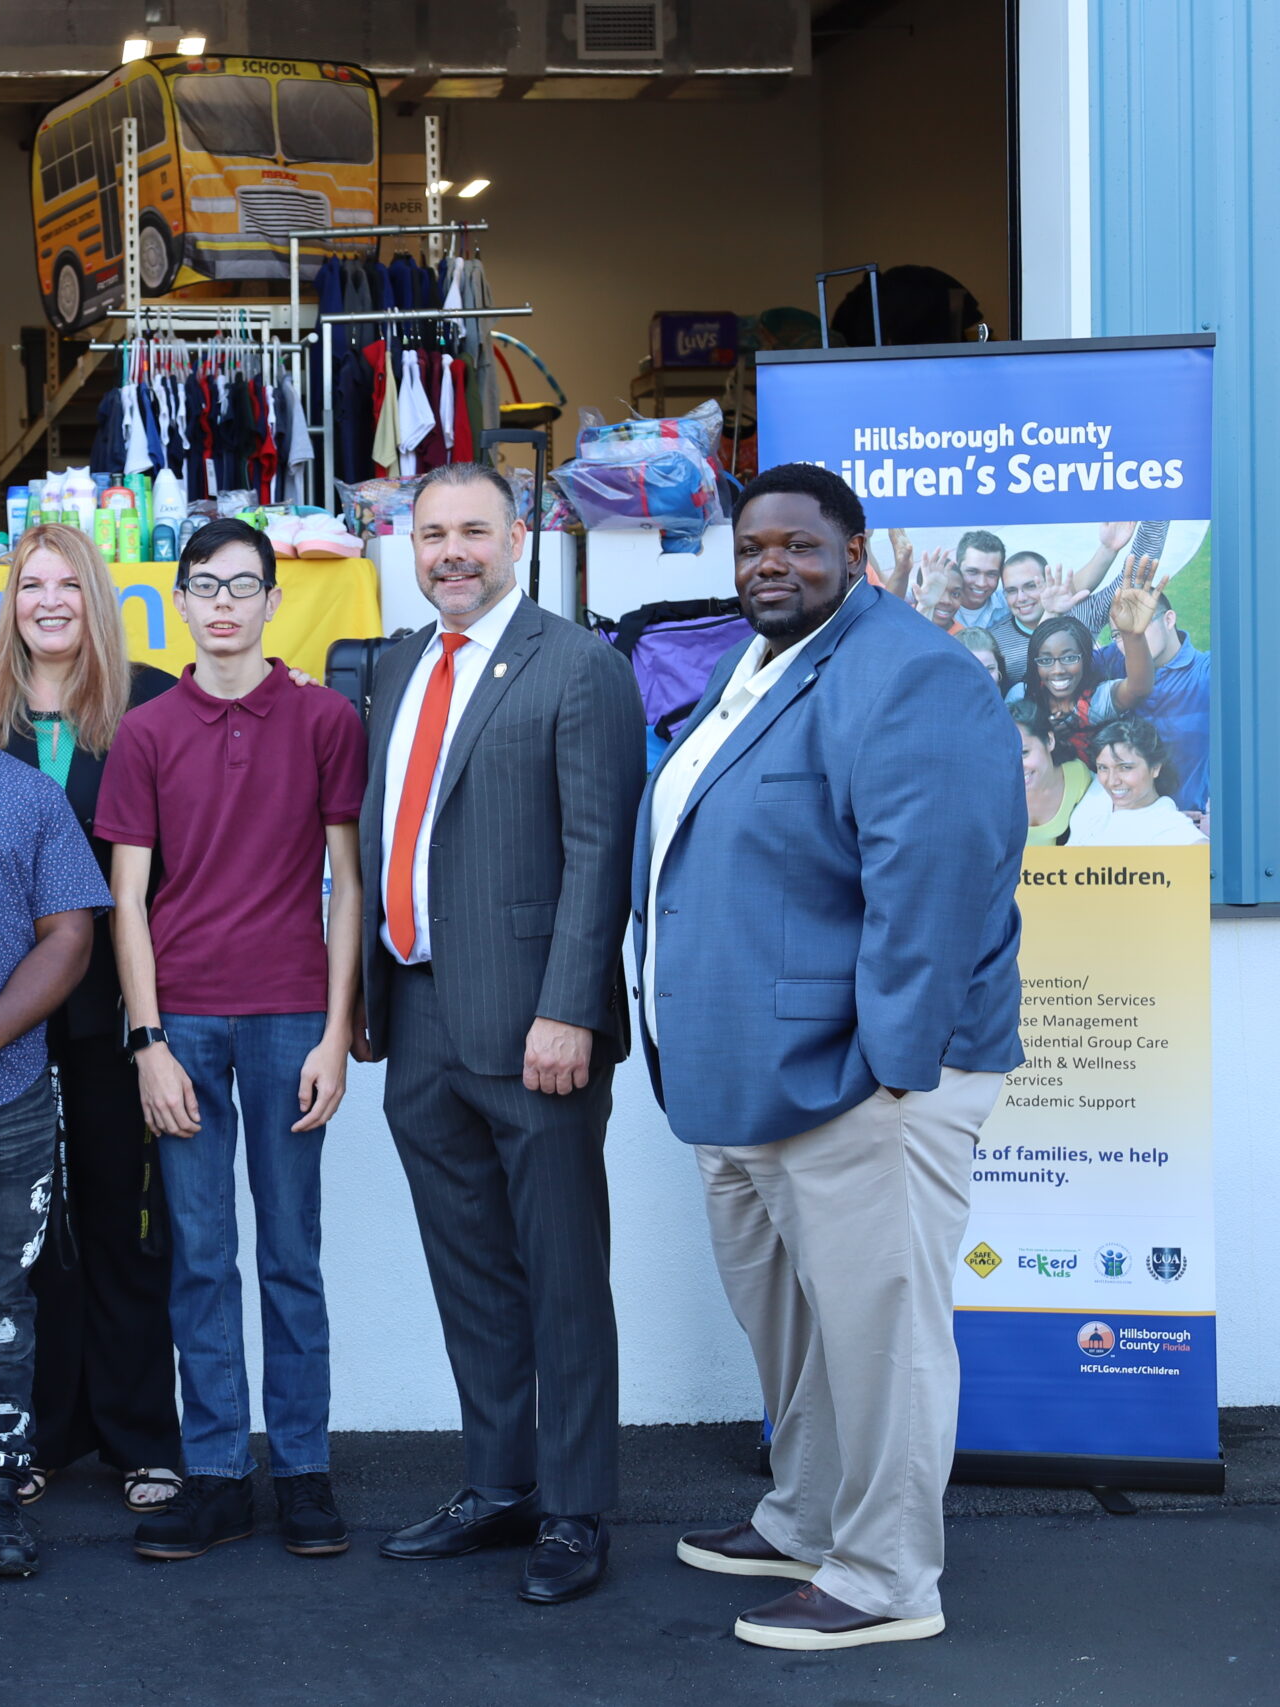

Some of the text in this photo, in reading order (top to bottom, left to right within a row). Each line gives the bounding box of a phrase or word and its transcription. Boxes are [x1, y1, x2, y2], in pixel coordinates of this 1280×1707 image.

[242, 60, 301, 76] SCHOOL
[384, 202, 423, 213] PAPER
[854, 422, 1112, 453] Hillsborough County
[794, 452, 1184, 498] ildren's Services
[1022, 867, 1171, 888] tect children,
[1020, 975, 1089, 990] evention/
[1097, 994, 1156, 1007] Services
[1042, 1015, 1139, 1030] Management
[1022, 1035, 1169, 1051] sidential Group Care
[1056, 1056, 1068, 1069] &
[1072, 1056, 1137, 1070] Wellness
[1005, 1074, 1064, 1087] Services
[1005, 1095, 1136, 1110] Academic Support
[992, 1146, 1012, 1160] of
[1016, 1146, 1092, 1164] families,
[1098, 1150, 1124, 1162] we
[1129, 1148, 1169, 1166] help
[970, 1168, 1069, 1187] ommunity.
[1153, 1252, 1180, 1264] COA
[1120, 1328, 1191, 1342] Hillsborough
[1120, 1340, 1160, 1353] County
[1080, 1364, 1180, 1375] HCFLGov.net/Children
